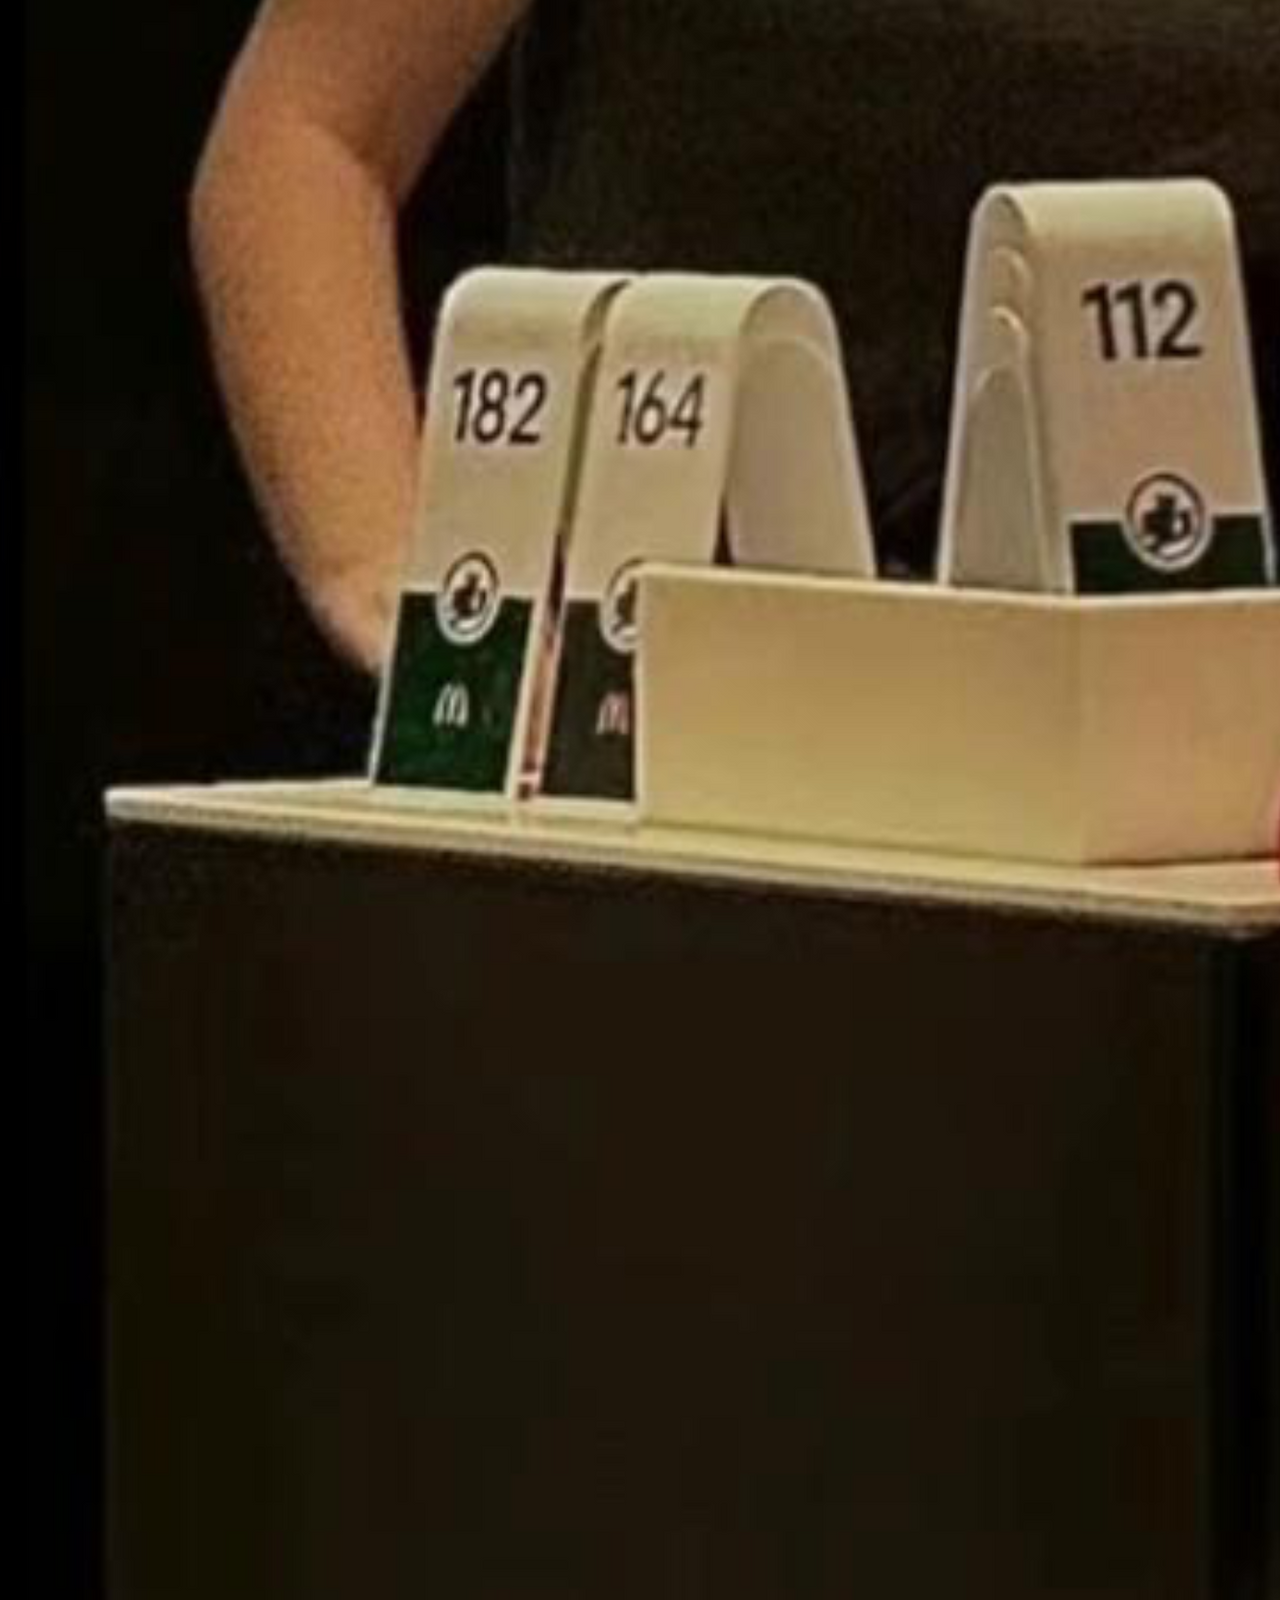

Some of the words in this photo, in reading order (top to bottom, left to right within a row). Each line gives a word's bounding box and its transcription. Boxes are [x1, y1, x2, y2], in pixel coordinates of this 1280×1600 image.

[1081, 279, 1203, 363] 112
[452, 367, 548, 445] 182
[616, 368, 706, 448] 164
